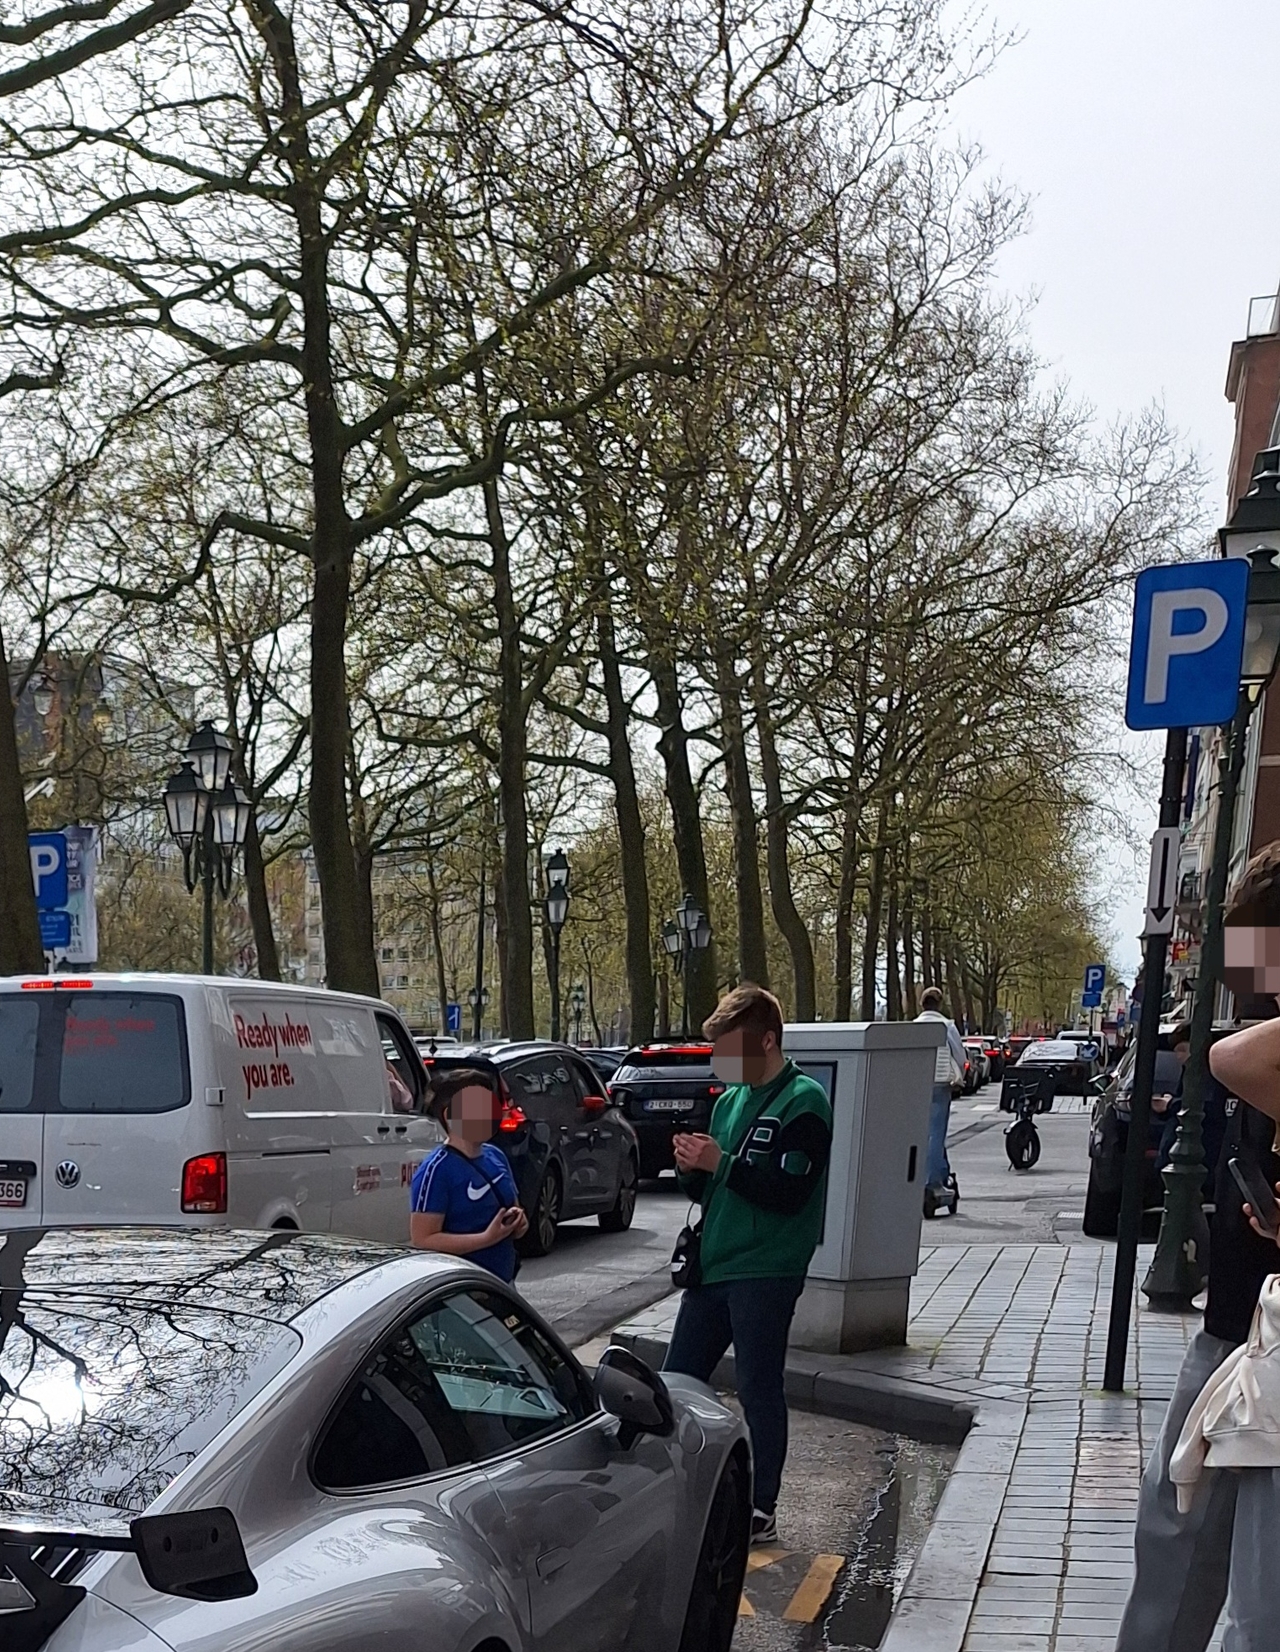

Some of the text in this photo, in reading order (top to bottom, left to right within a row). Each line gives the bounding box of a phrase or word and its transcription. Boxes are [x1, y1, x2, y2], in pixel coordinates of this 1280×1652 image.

[1144, 588, 1229, 704] P
[30, 845, 60, 897] P
[1087, 968, 1102, 989] P
[233, 1012, 312, 1058] Ready when
[242, 1063, 295, 1100] you are.
